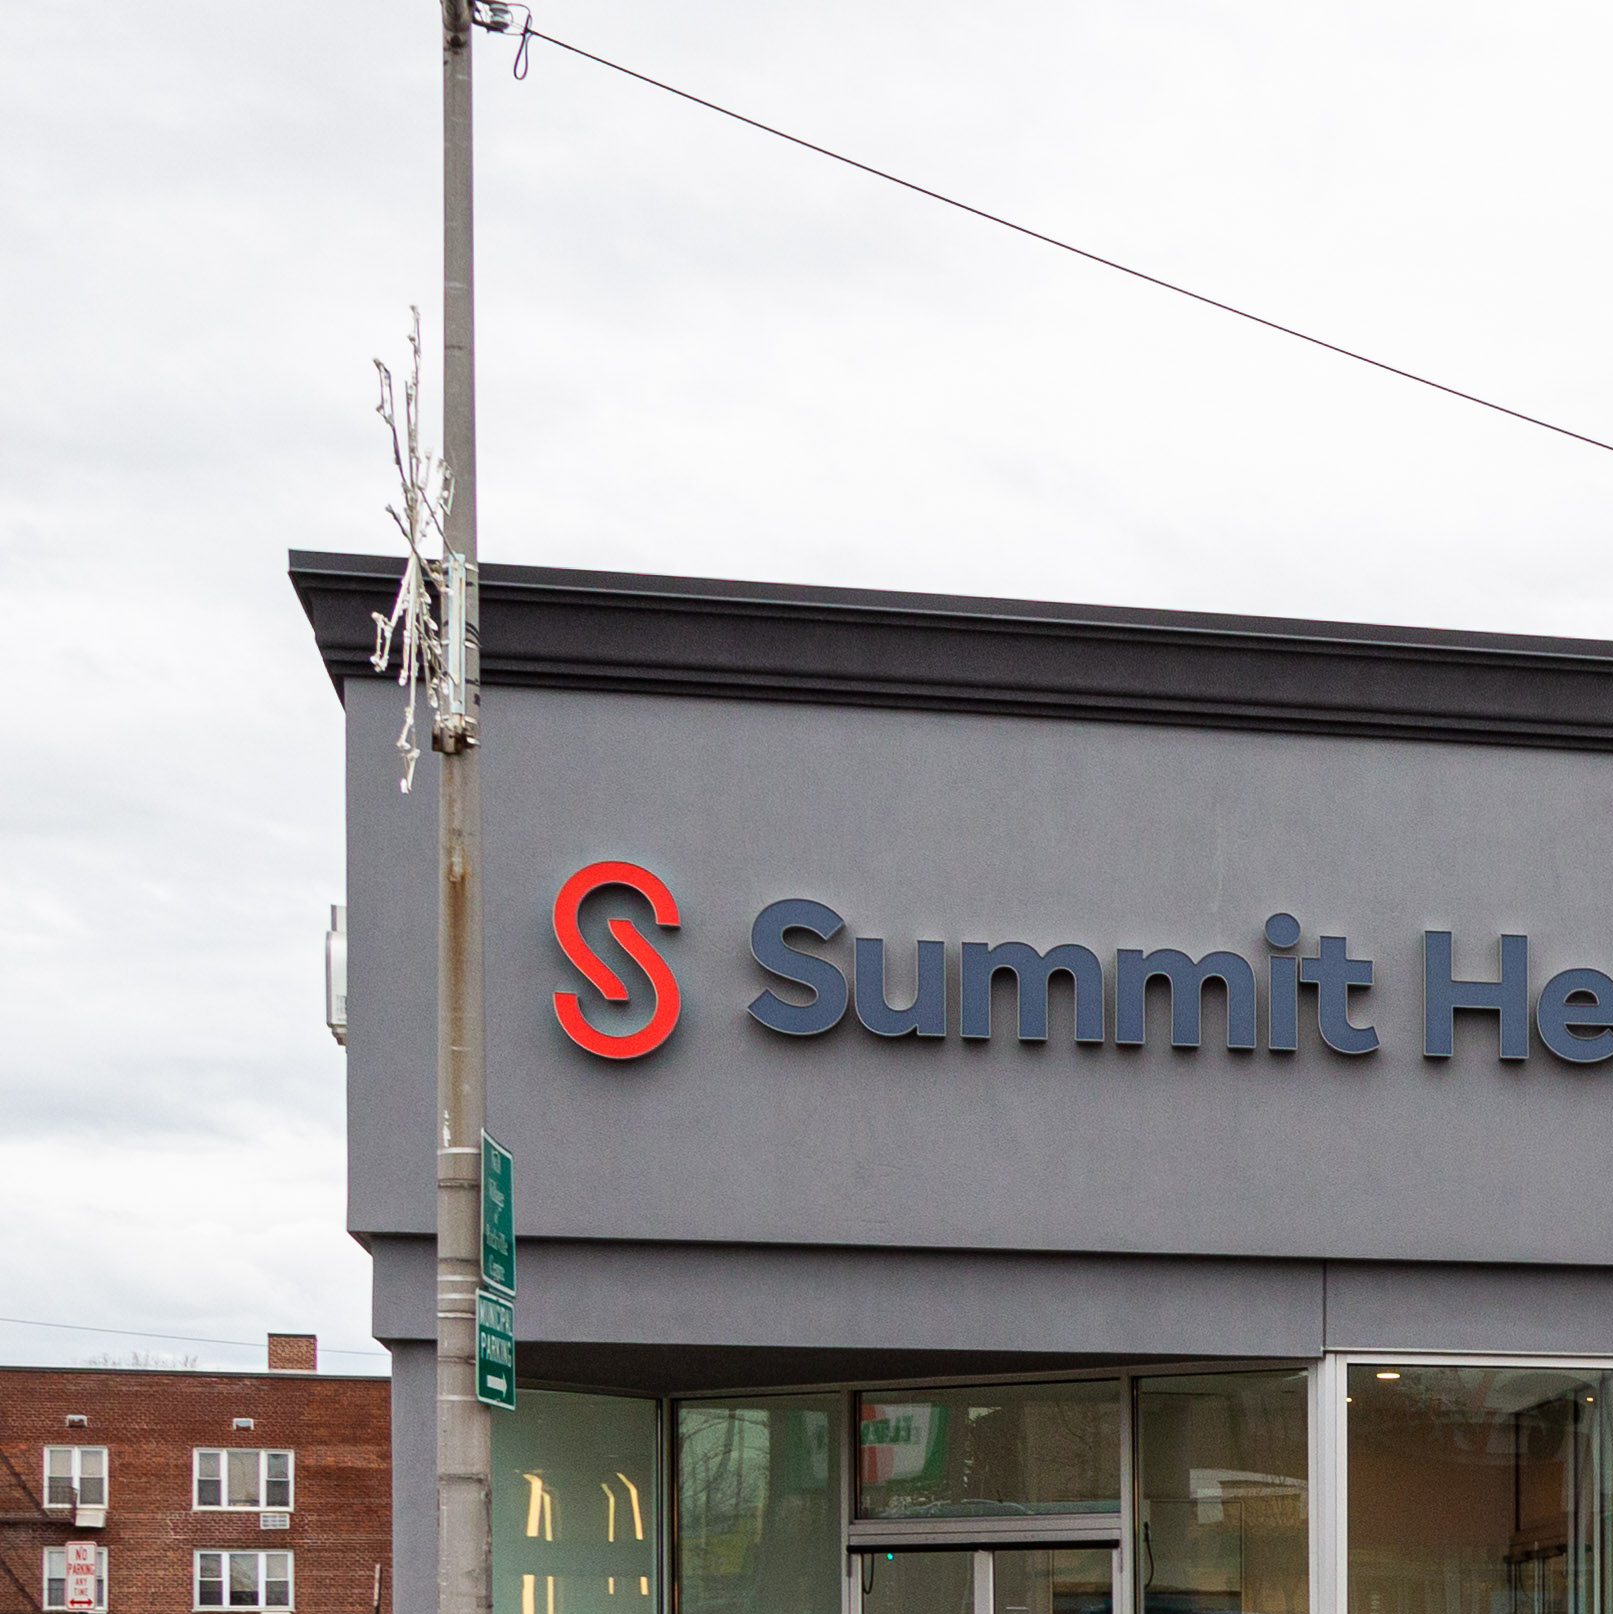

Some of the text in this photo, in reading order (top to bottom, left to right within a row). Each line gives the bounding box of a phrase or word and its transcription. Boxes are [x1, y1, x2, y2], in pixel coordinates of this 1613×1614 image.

[747, 896, 1380, 1055] Summit
[479, 1298, 514, 1336] MUNICIPAL
[480, 1331, 512, 1368] PARKING
[75, 1549, 88, 1561] NO
[67, 1563, 95, 1575] PARKING
[74, 1587, 88, 1597] TIME
